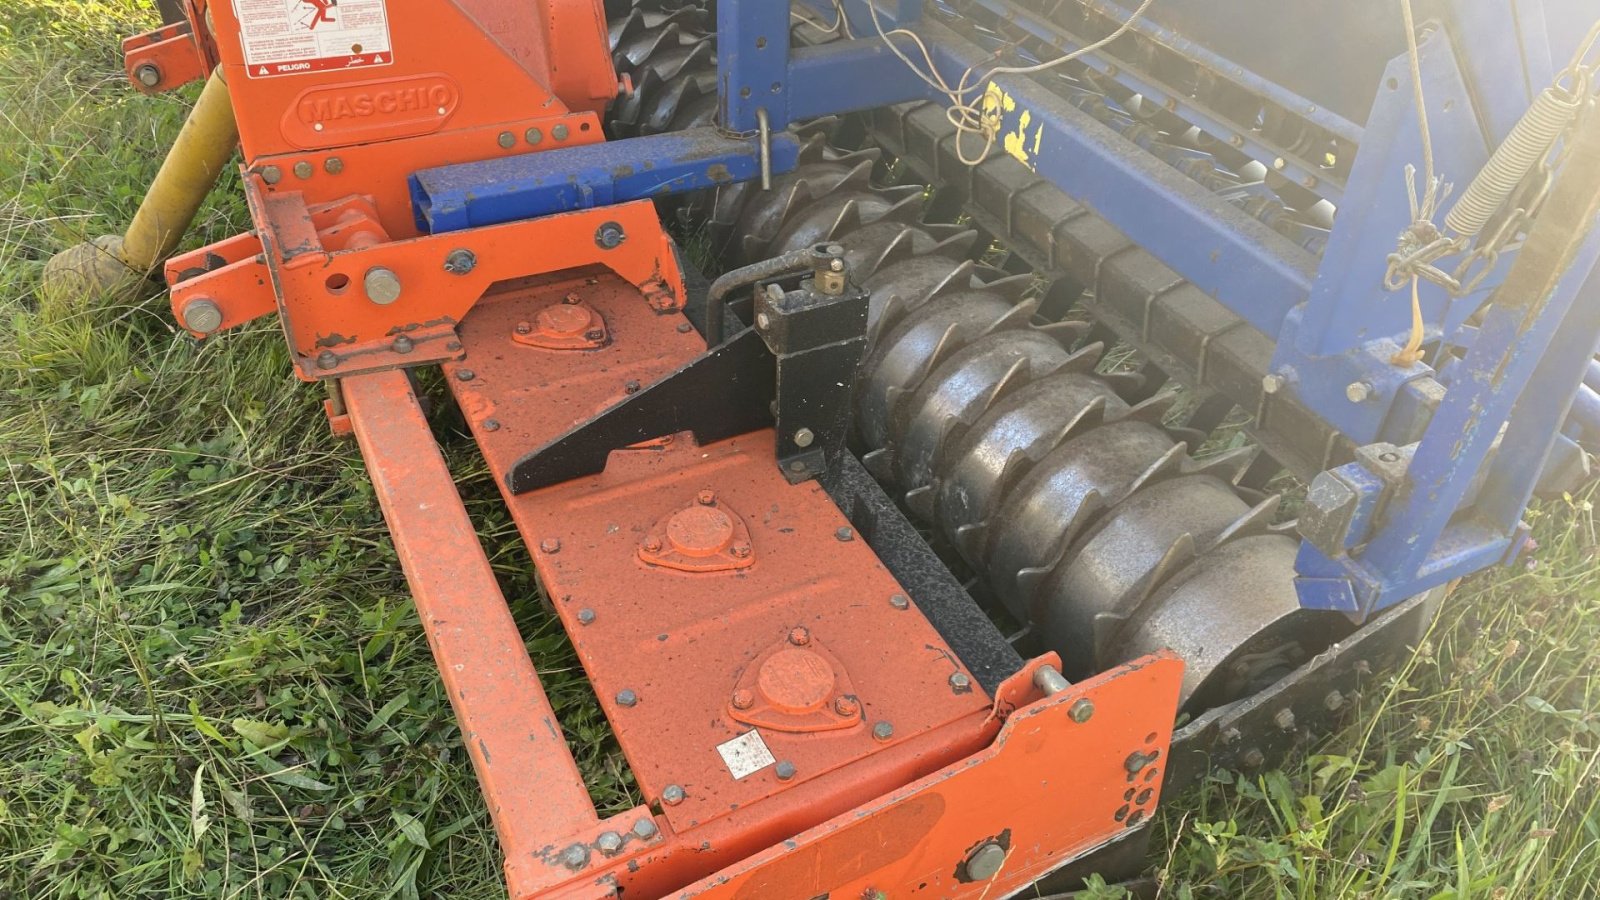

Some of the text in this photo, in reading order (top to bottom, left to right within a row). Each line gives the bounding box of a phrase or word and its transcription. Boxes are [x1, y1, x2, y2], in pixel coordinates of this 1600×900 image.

[277, 62, 311, 72] PELIGRO
[344, 56, 365, 67] خطر
[302, 84, 451, 123] MASCHIO
